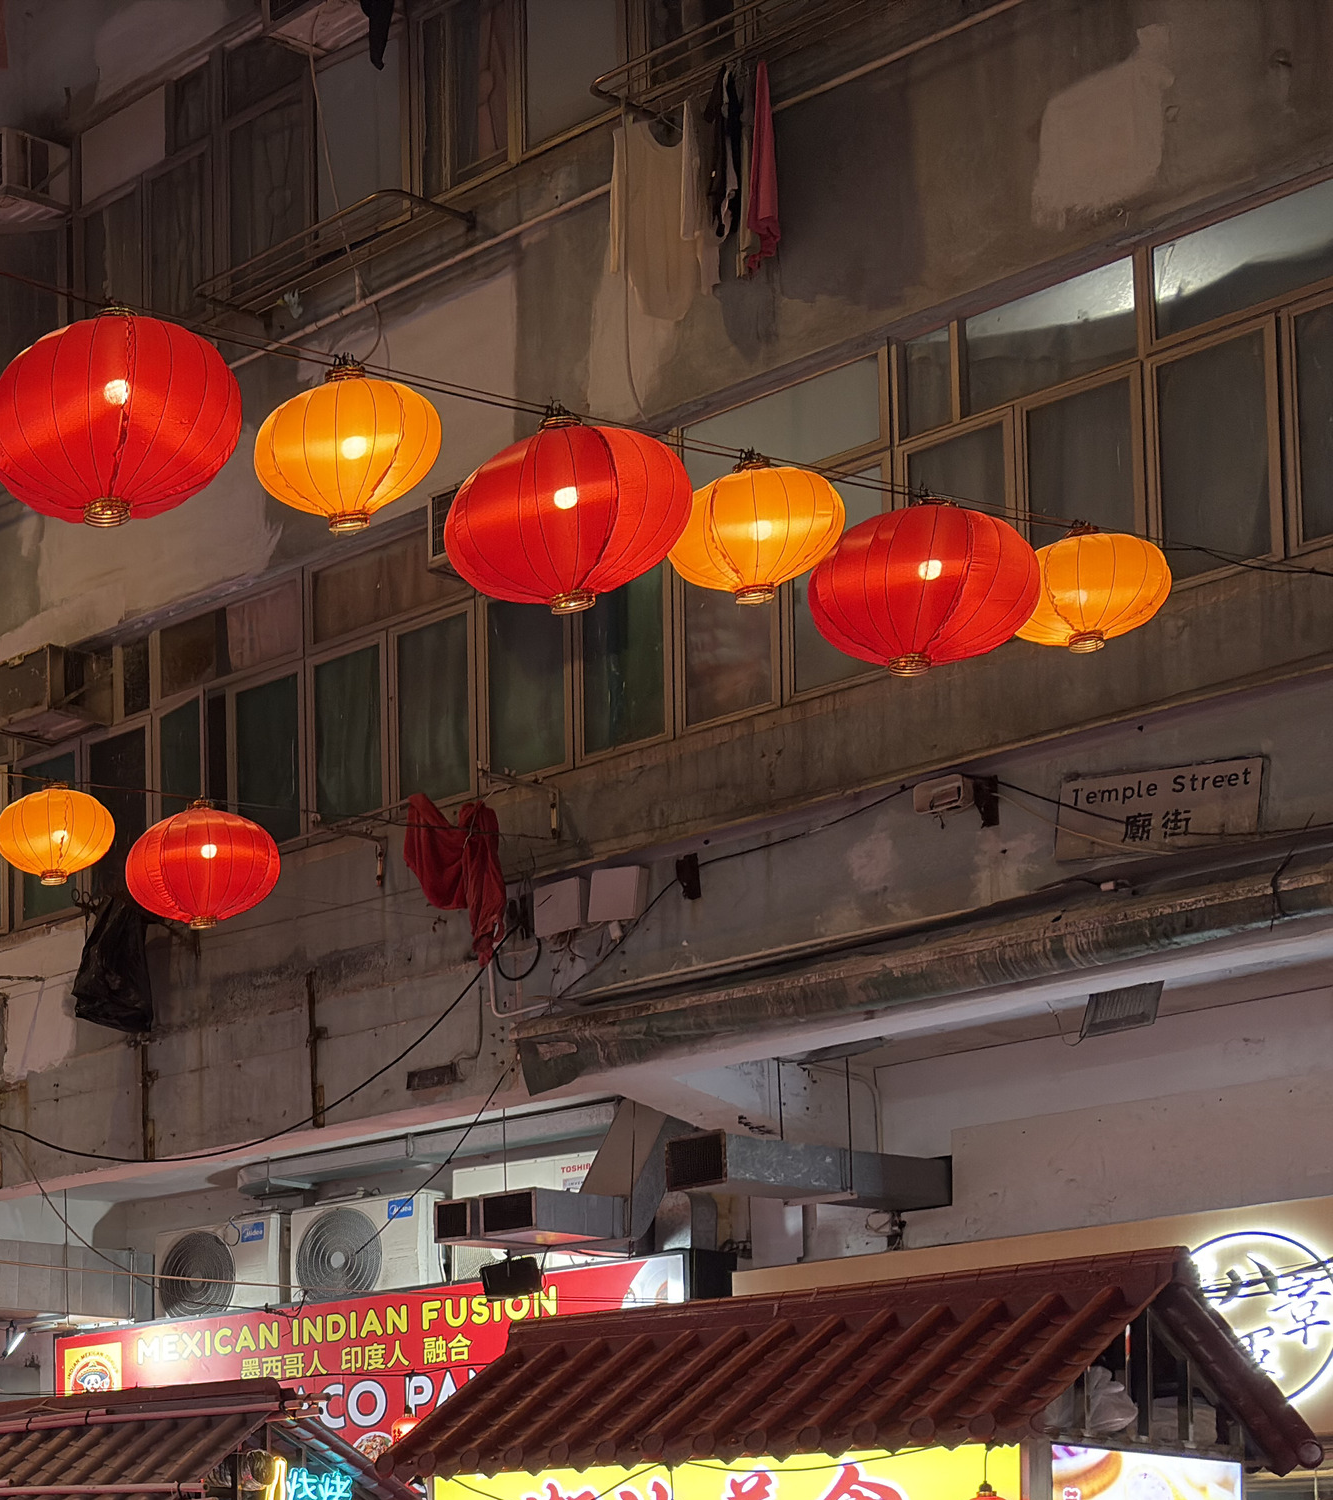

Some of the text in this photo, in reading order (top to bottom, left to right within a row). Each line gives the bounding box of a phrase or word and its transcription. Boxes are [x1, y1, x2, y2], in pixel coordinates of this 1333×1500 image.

[1071, 766, 1252, 807] Temple Street
[1120, 807, 1191, 843] 廟街
[136, 1285, 559, 1366] MEXICAN INDIAN FUSION
[240, 1332, 473, 1382] 墨西哥人 印度人 融合
